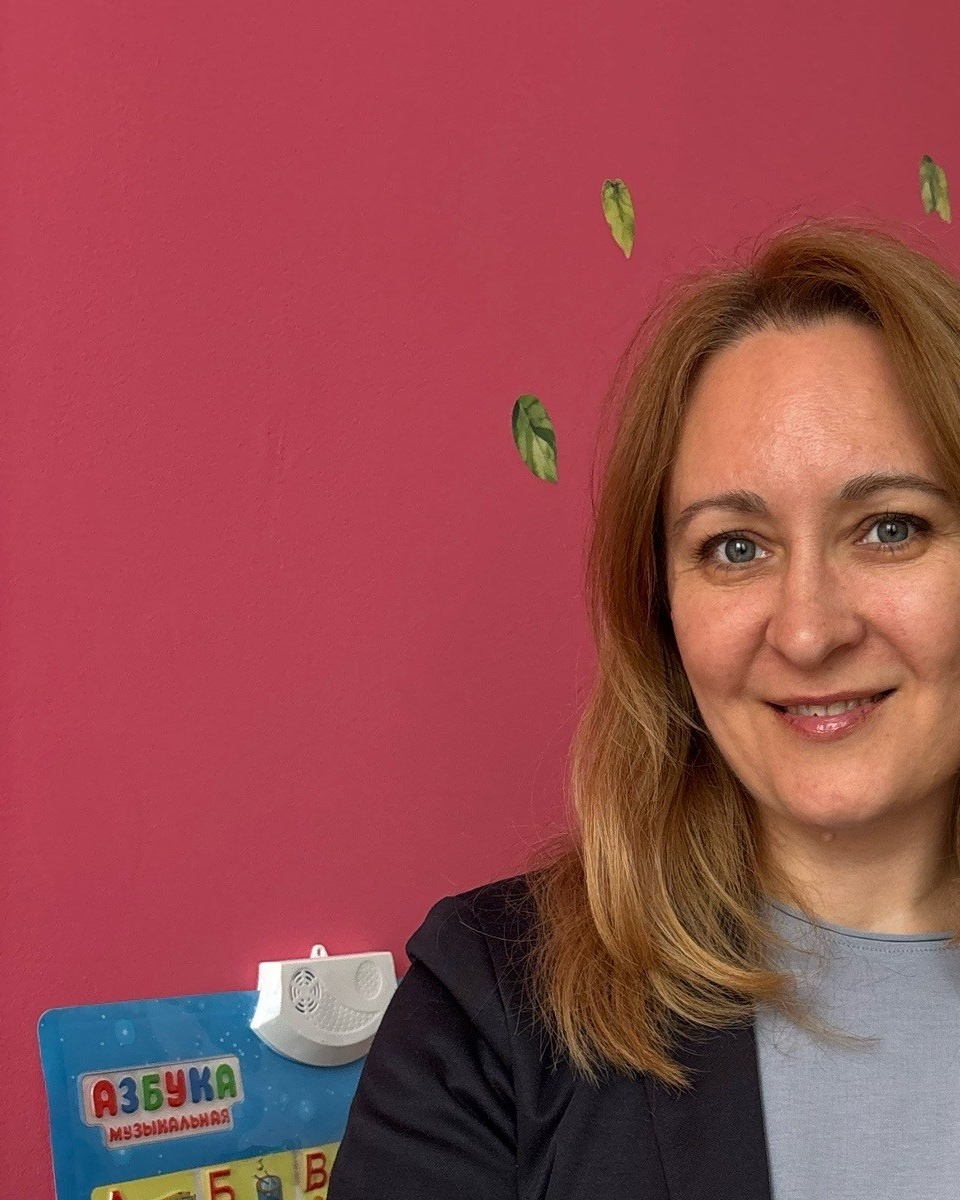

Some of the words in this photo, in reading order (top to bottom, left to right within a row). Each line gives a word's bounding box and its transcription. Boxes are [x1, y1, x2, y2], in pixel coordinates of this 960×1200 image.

[92, 1063, 237, 1118] АЗБУКА
[109, 1108, 230, 1142] МУЗЫКАЛЬНАЯ
[304, 1152, 328, 1193] В
